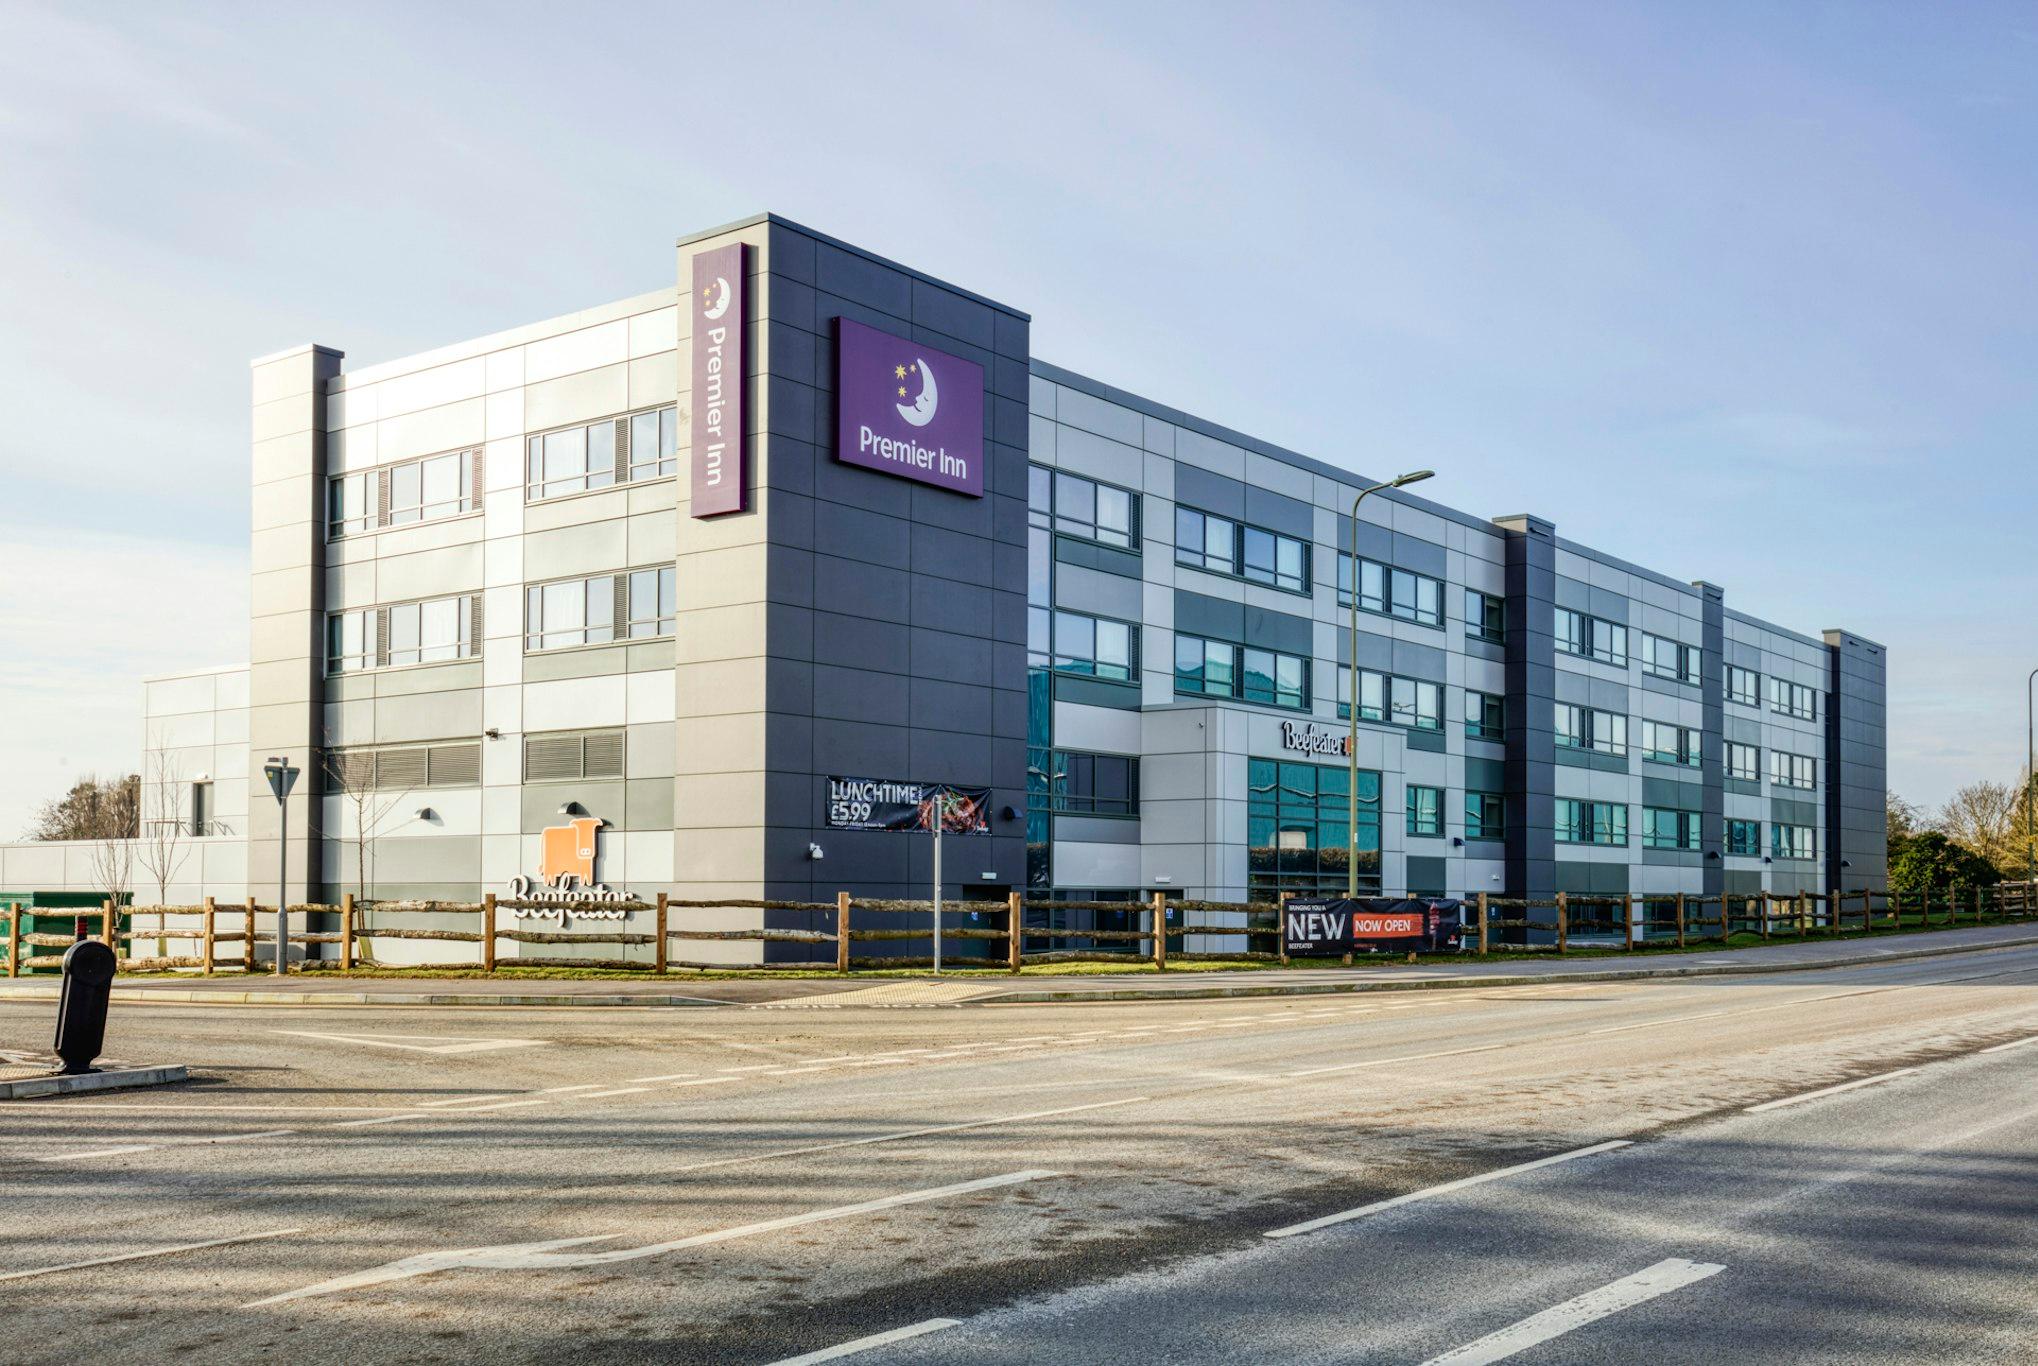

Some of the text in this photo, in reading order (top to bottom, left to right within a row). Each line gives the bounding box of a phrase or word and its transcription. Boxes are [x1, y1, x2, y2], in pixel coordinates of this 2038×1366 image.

[705, 327, 727, 486] Premier Inn
[859, 425, 967, 480] Premier Inn
[1284, 721, 1343, 757] Beefeater
[831, 780, 919, 805] LUNCHTIME
[831, 801, 871, 821] £5.99
[1288, 913, 1346, 941] NEW
[1355, 919, 1412, 932] NOW OPEN
